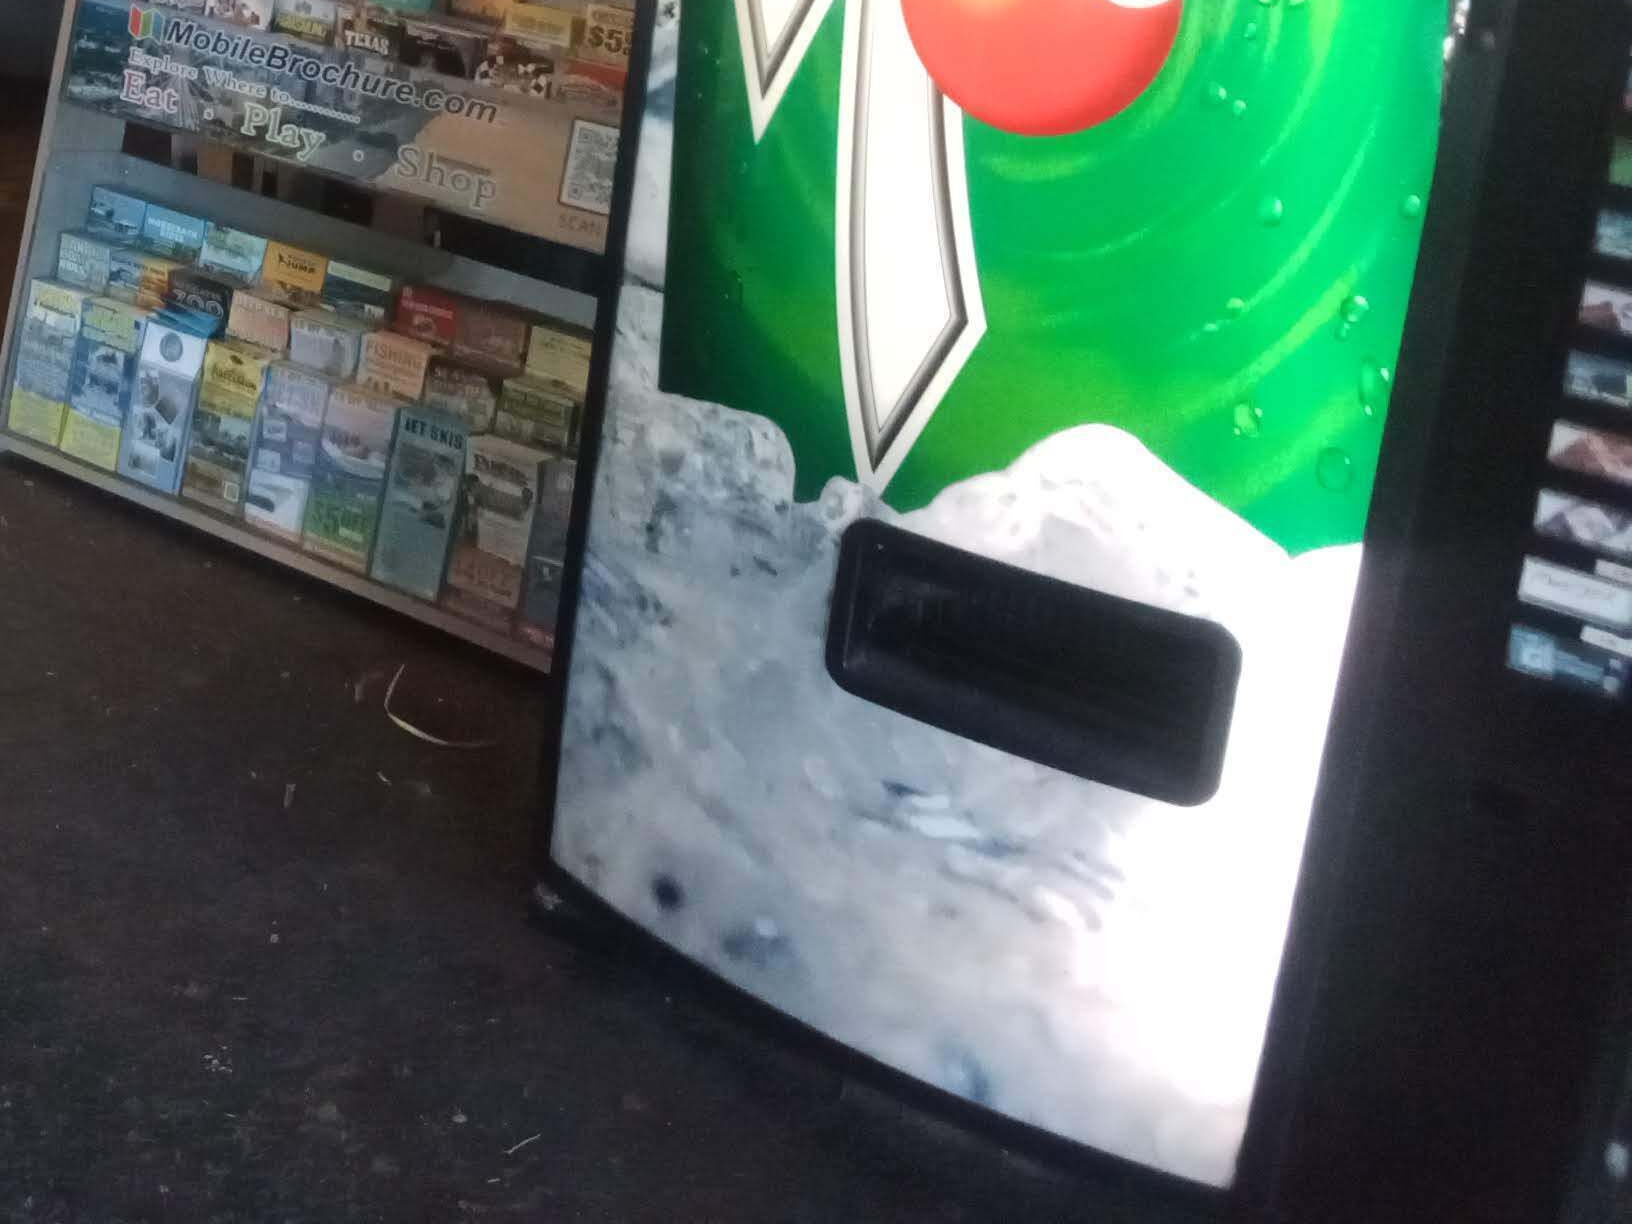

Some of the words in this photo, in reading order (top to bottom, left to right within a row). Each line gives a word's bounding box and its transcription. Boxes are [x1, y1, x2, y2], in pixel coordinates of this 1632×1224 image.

[344, 29, 390, 56] TEXAS
[120, 70, 179, 115] Eat
[128, 47, 198, 81] Explore
[203, 65, 267, 101] Where
[167, 20, 498, 124] MobileBrochure.com
[241, 101, 325, 163] Play
[397, 143, 497, 209] Shop
[405, 418, 427, 435] JET
[430, 428, 463, 450] SKIS
